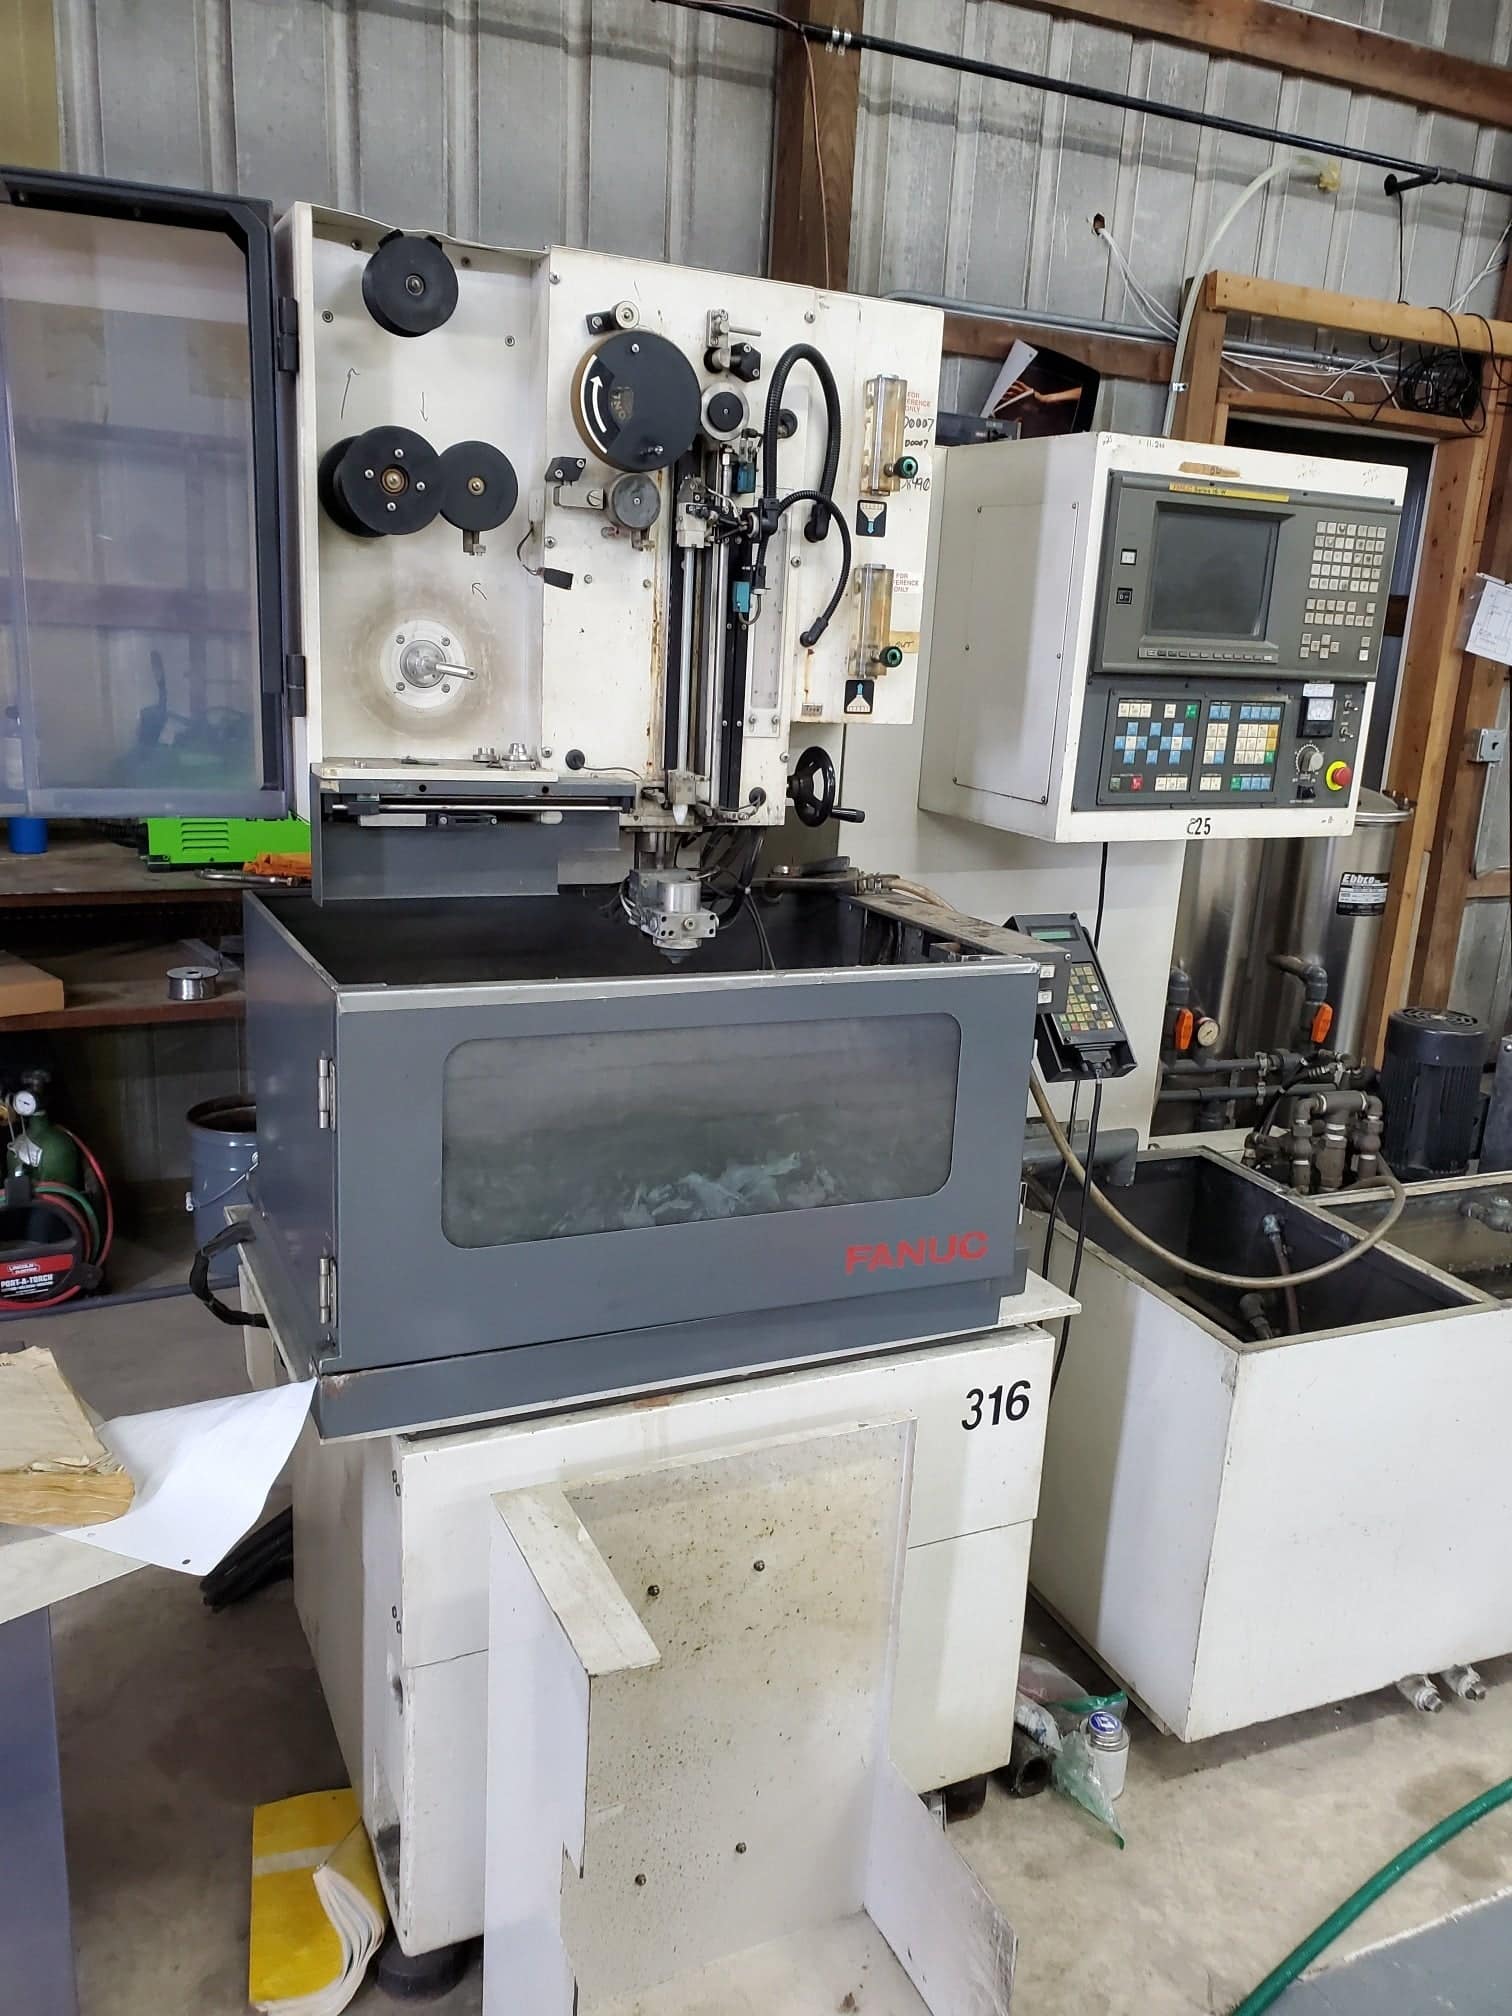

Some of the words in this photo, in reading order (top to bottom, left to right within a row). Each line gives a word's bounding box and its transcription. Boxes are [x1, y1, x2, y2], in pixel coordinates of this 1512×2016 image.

[906, 399, 930, 408] ERENCE
[894, 579, 919, 587] ERENCE
[845, 1231, 989, 1275] FANUC
[961, 1379, 1031, 1430] 316
